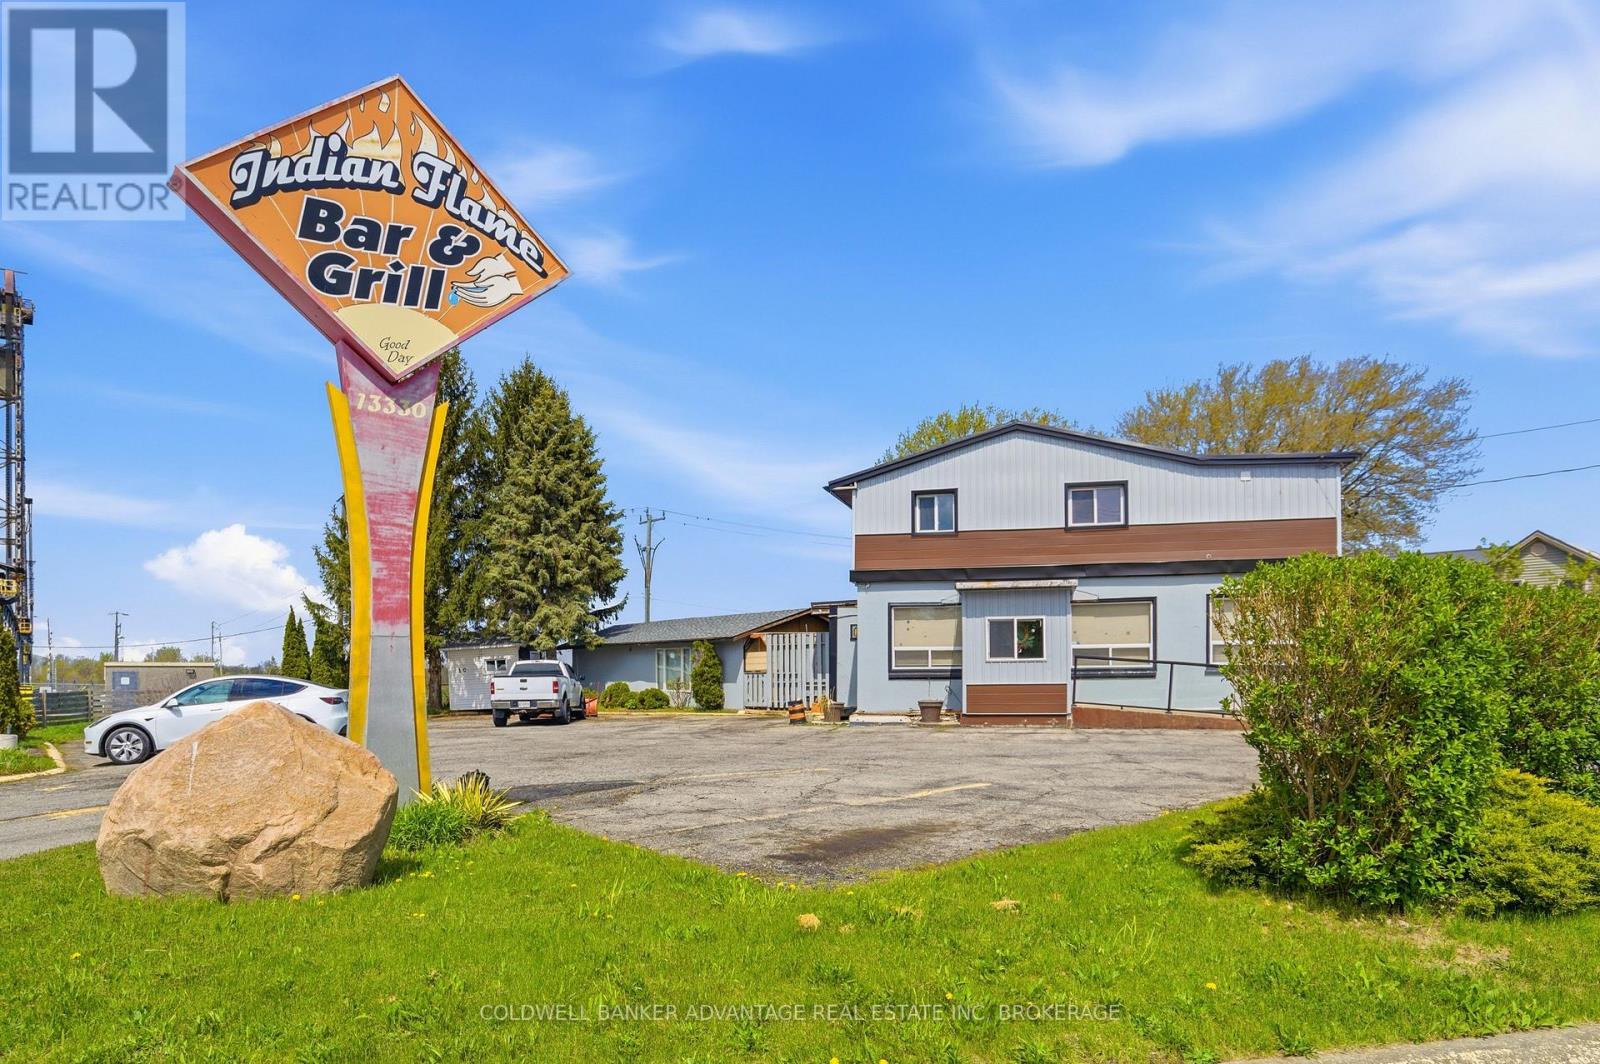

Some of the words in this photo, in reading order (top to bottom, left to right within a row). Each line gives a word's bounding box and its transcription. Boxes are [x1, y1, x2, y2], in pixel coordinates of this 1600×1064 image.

[230, 132, 406, 210] Indian
[411, 152, 549, 279] Flame
[297, 195, 416, 256] Bar
[427, 224, 482, 268] &
[305, 250, 448, 311] Grill
[379, 336, 411, 350] Good
[387, 350, 415, 366] Day
[356, 393, 427, 418] 13330
